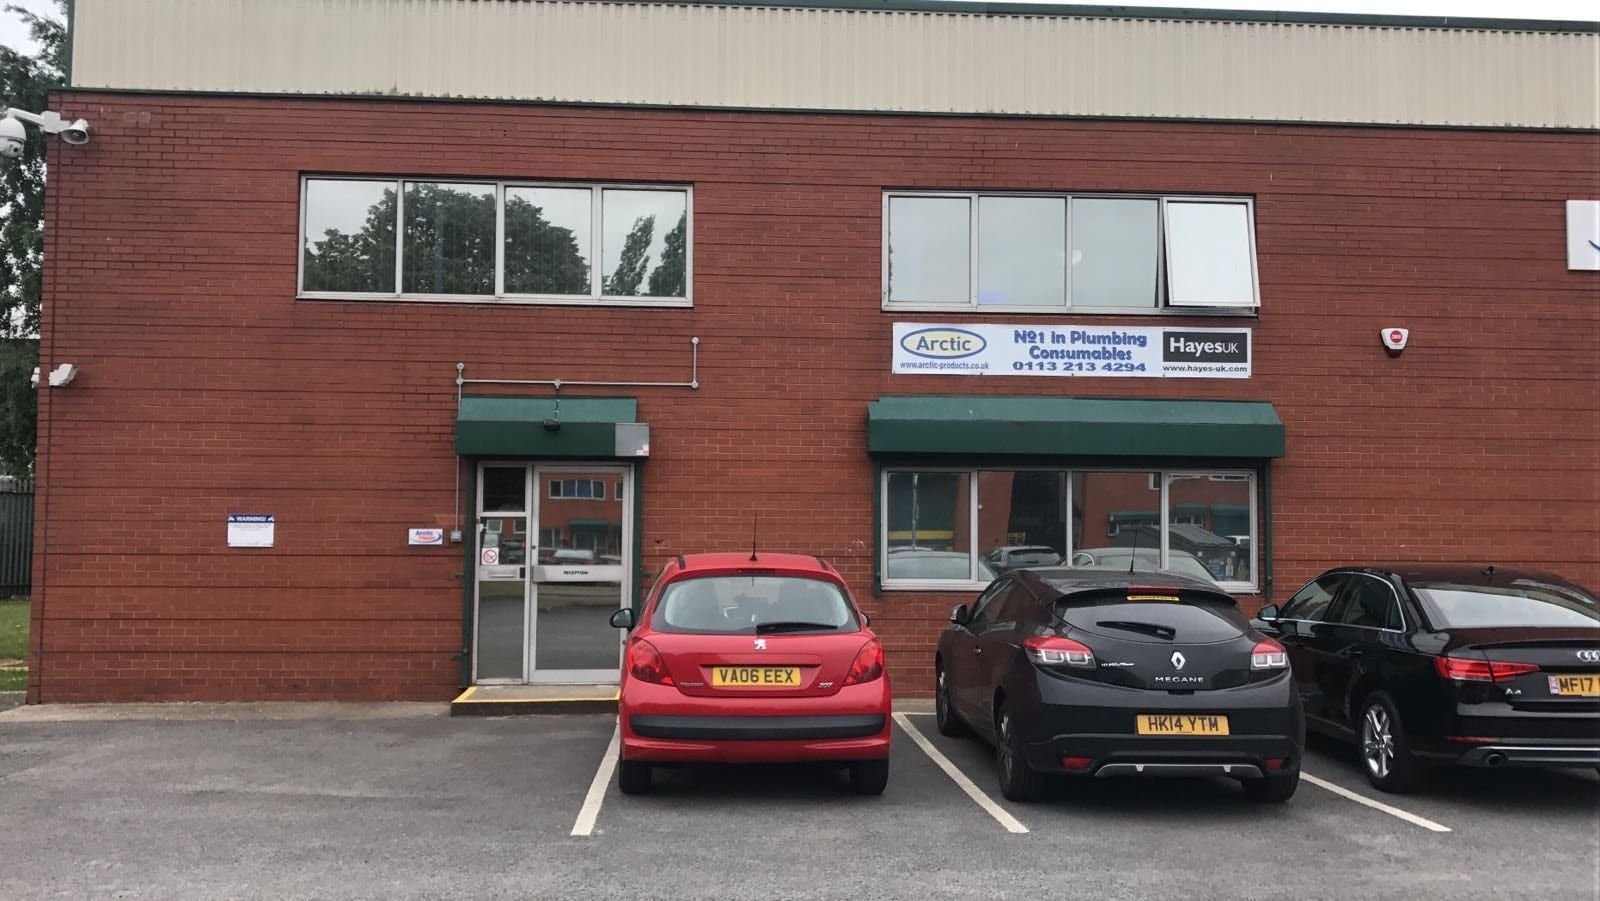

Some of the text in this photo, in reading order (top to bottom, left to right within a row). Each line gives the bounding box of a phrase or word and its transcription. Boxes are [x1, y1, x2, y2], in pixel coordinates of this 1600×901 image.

[916, 336, 971, 351] Arctic
[1051, 331, 1066, 344] in
[1070, 331, 1147, 347] Plumbing
[1029, 346, 1132, 360] Consumables
[900, 361, 989, 370] www.arctic-products.co.uk
[1013, 362, 1146, 372] 0113 213 4294
[1163, 364, 1248, 372] www.hayes-uk.com
[720, 669, 794, 683] VA06 EEX
[1559, 677, 1593, 692] MF17
[1148, 717, 1218, 732] HK14 YTM
